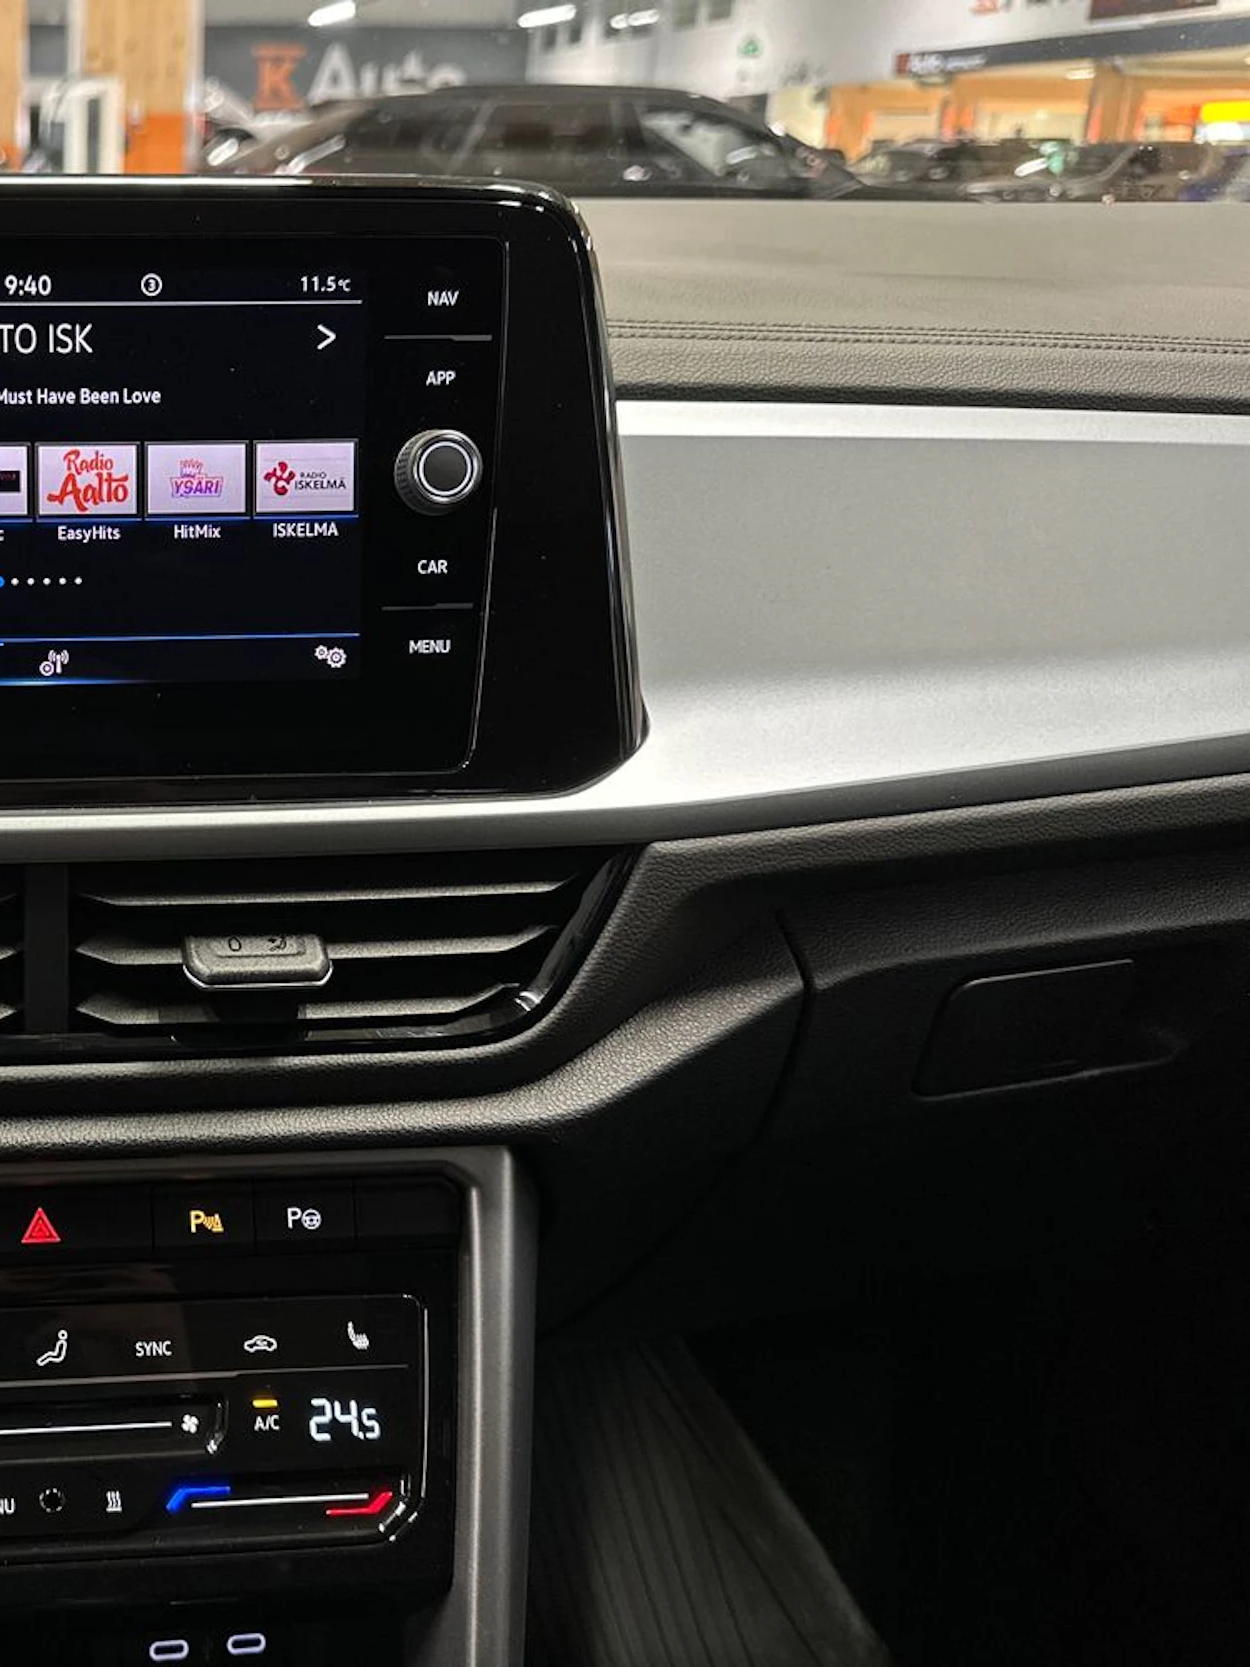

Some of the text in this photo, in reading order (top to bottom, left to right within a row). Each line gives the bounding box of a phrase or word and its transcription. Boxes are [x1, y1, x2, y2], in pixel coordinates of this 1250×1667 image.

[253, 42, 306, 109] K
[4, 274, 53, 296] 9:40
[427, 290, 460, 307] NAV
[48, 322, 93, 355] ISK
[425, 370, 456, 386] APP
[36, 387, 77, 405] Have
[79, 387, 120, 405] Been
[122, 387, 162, 405] Love
[63, 449, 114, 475] Radio
[46, 473, 129, 512] Aalto
[57, 524, 121, 544] EasyHits
[173, 523, 221, 540] HitMix
[417, 559, 448, 575] CAR
[409, 639, 451, 655] MENU
[287, 1206, 302, 1229] P
[135, 1340, 173, 1357] SYNC
[254, 1414, 280, 1432] A/C
[309, 1397, 381, 1442] 24.5
